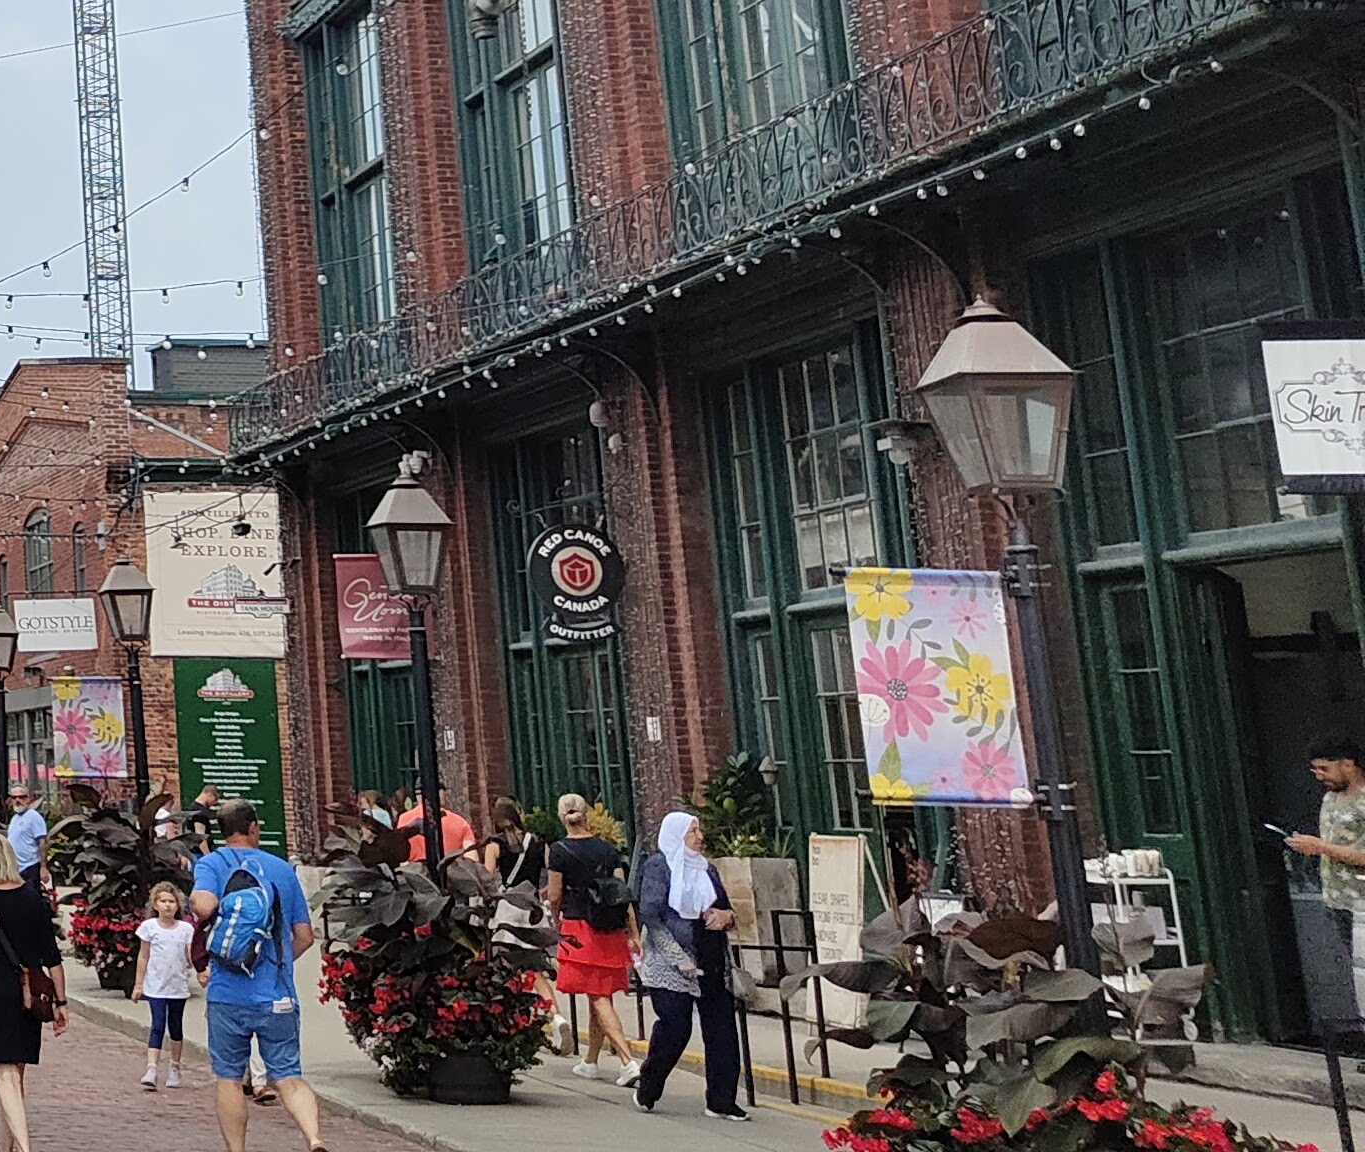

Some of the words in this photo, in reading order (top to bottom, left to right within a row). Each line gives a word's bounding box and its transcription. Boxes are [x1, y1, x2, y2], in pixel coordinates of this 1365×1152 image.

[1283, 388, 1343, 425] Skin
[538, 533, 563, 558] RED
[563, 529, 612, 557] CANOE
[180, 545, 274, 558] EXPLORE.
[191, 599, 210, 607] THE
[553, 595, 610, 613] CANADA
[18, 615, 94, 630] GOTSTYLE
[177, 628, 205, 637] Leasing
[549, 624, 616, 640] OUTFITTER
